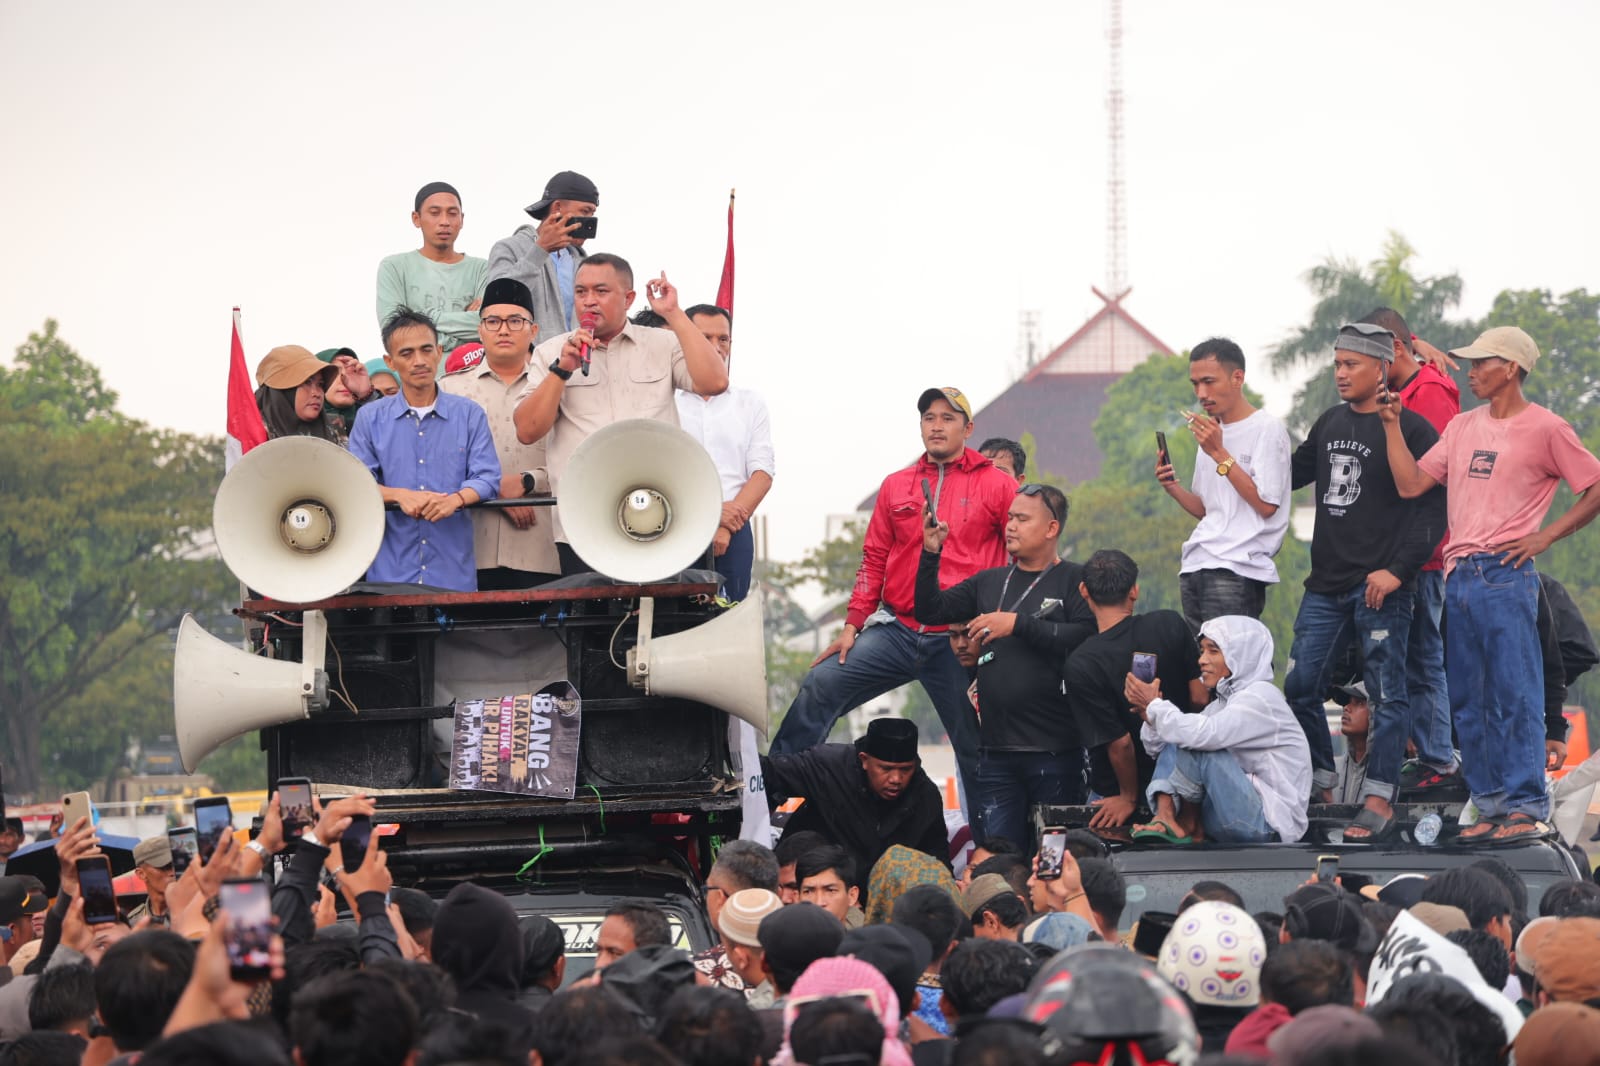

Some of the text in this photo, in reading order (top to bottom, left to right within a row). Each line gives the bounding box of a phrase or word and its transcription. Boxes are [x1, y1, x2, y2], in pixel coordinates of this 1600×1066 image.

[1327, 440, 1371, 457] BELIEVE
[1323, 453, 1362, 506] B
[481, 722, 499, 783] PIHAK!
[499, 706, 512, 749] UNTUK
[511, 698, 529, 764] RAKYAT,
[528, 694, 552, 769] BANG
